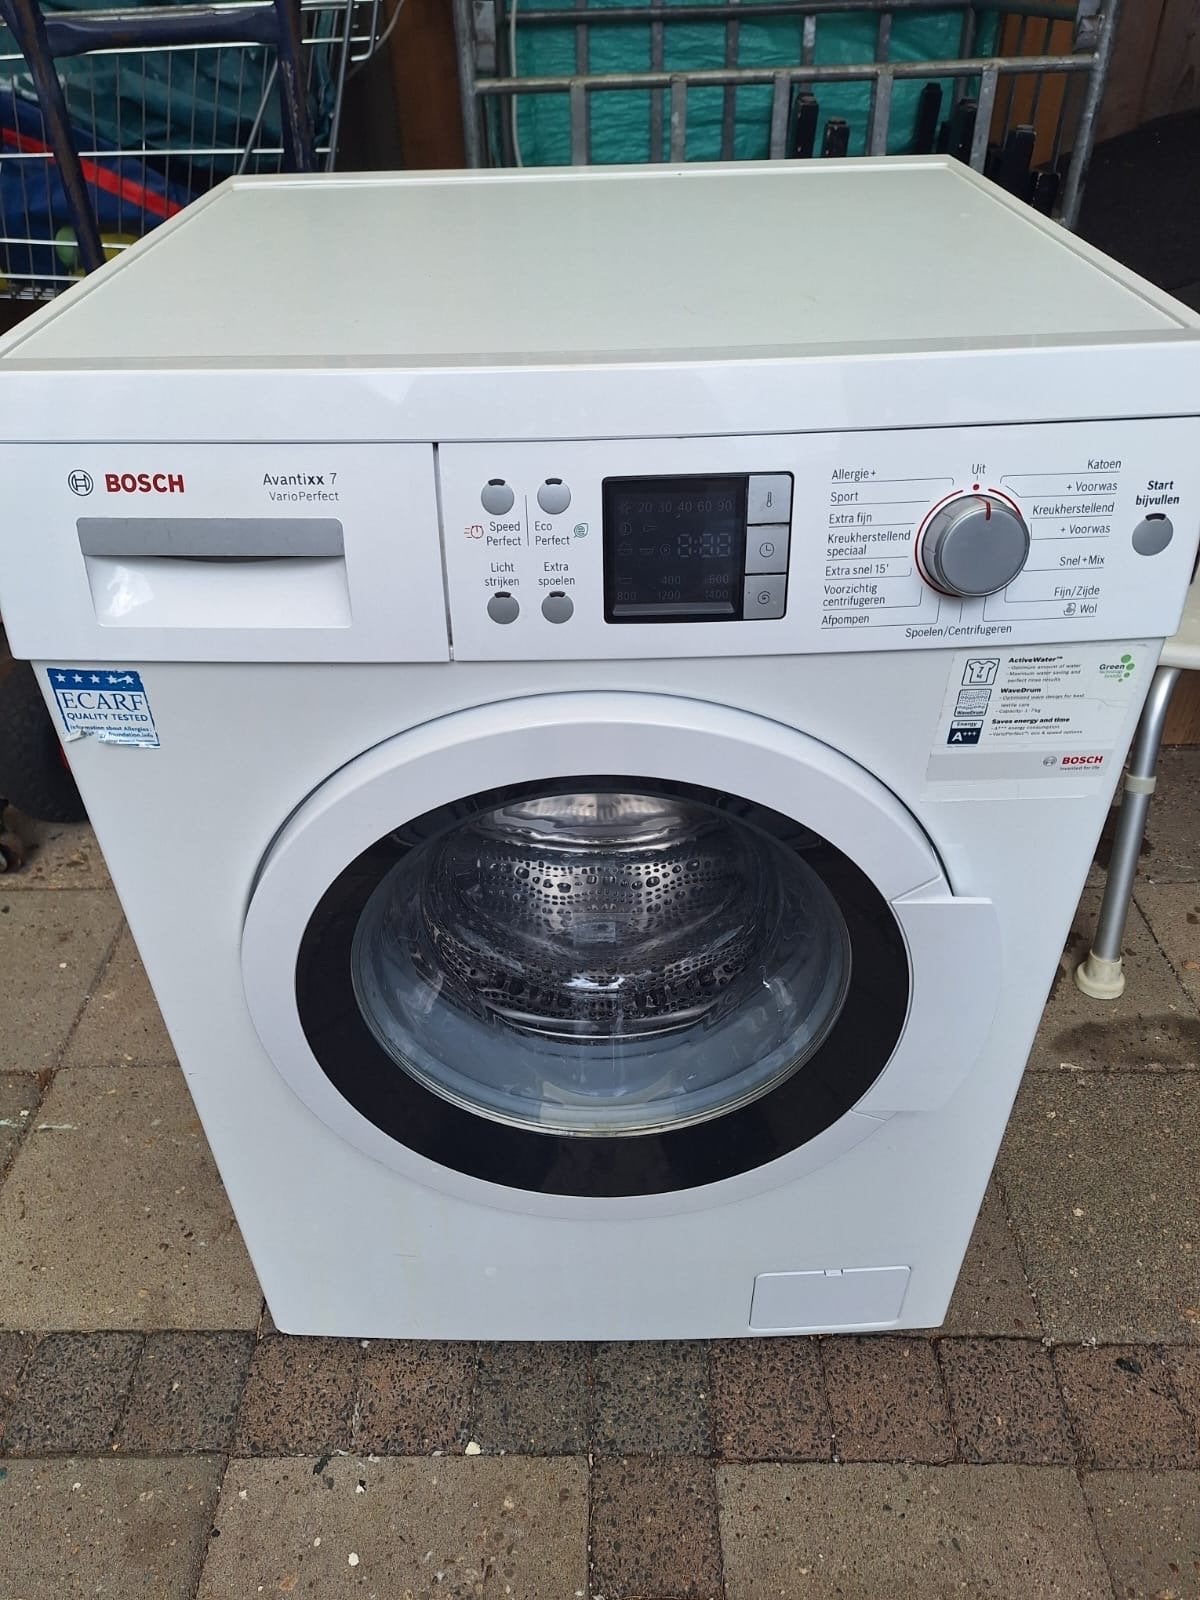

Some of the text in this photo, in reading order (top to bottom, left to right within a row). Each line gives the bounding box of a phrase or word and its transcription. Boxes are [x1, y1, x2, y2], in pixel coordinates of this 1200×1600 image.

[972, 464, 986, 474] Uit
[1087, 459, 1122, 470] Katoen
[105, 473, 185, 493] BOSCH
[263, 473, 337, 486] Avantixx 7
[1147, 480, 1174, 490] Start
[1076, 481, 1118, 492] Voorwas
[269, 491, 340, 502] VarioPerfect
[830, 492, 859, 503] Sport
[1136, 494, 1180, 507] bijvullen
[1032, 502, 1115, 516] Kreukherstellend
[829, 512, 872, 525] Extra fijn
[489, 521, 520, 533] Speed
[534, 521, 552, 531] Eco
[1070, 524, 1111, 534] Voorwas
[486, 536, 522, 546] Perfect
[535, 536, 570, 546] Perfect
[828, 530, 911, 544] Kreukherstellend
[826, 545, 866, 558] speciaal
[490, 562, 515, 572] Licht
[544, 562, 569, 572] Extra
[825, 566, 850, 576] Extra
[853, 564, 872, 574] snel
[484, 577, 520, 588] strijken
[538, 576, 576, 588] spoelen
[824, 584, 878, 596] Voorzichtig
[1054, 586, 1100, 598] Fijn/Zijde
[822, 596, 886, 607] centrifugeren
[1080, 604, 1098, 614] Wol
[822, 615, 870, 626] Afpompen
[905, 624, 1012, 639] Spoelen/Centrifugeren
[60, 692, 143, 712] ECARF
[66, 712, 148, 722] QUALITY TESTED
[1062, 756, 1104, 764] BOSCH
